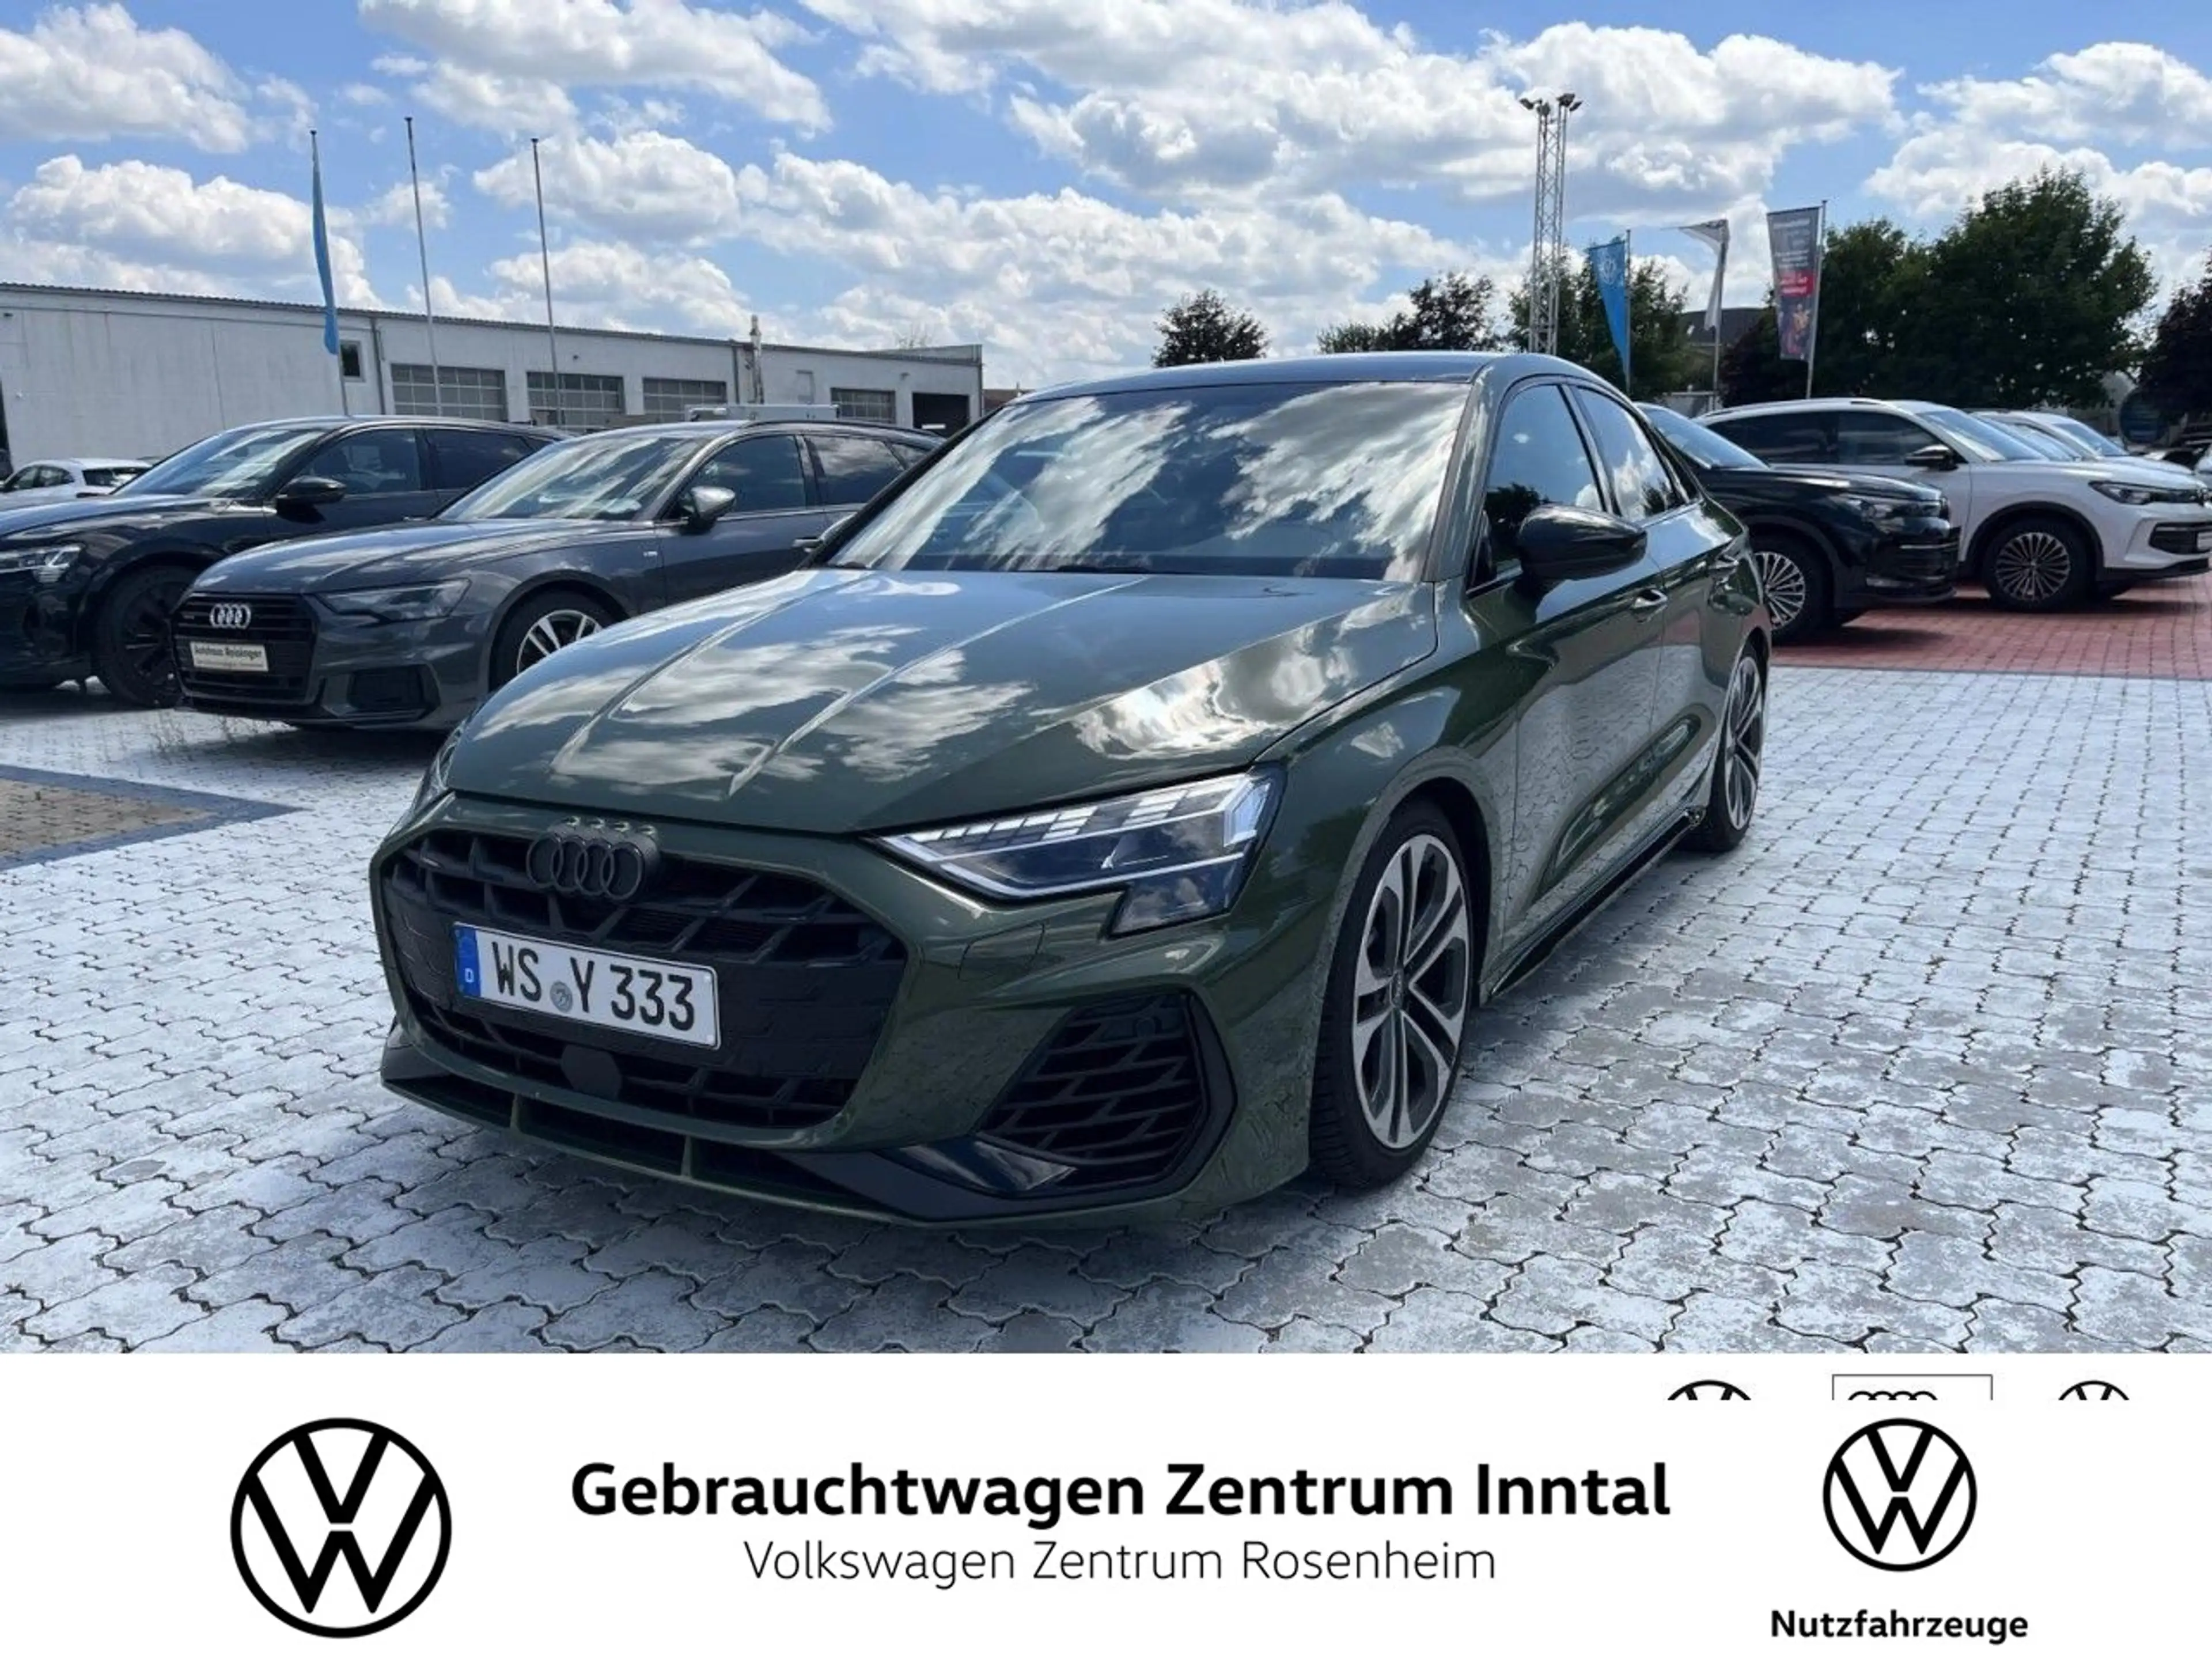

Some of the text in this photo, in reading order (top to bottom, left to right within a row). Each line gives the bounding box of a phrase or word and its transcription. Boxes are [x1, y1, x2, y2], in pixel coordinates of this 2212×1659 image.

[464, 967, 474, 983] D
[491, 941, 695, 1031] WS Y 333
